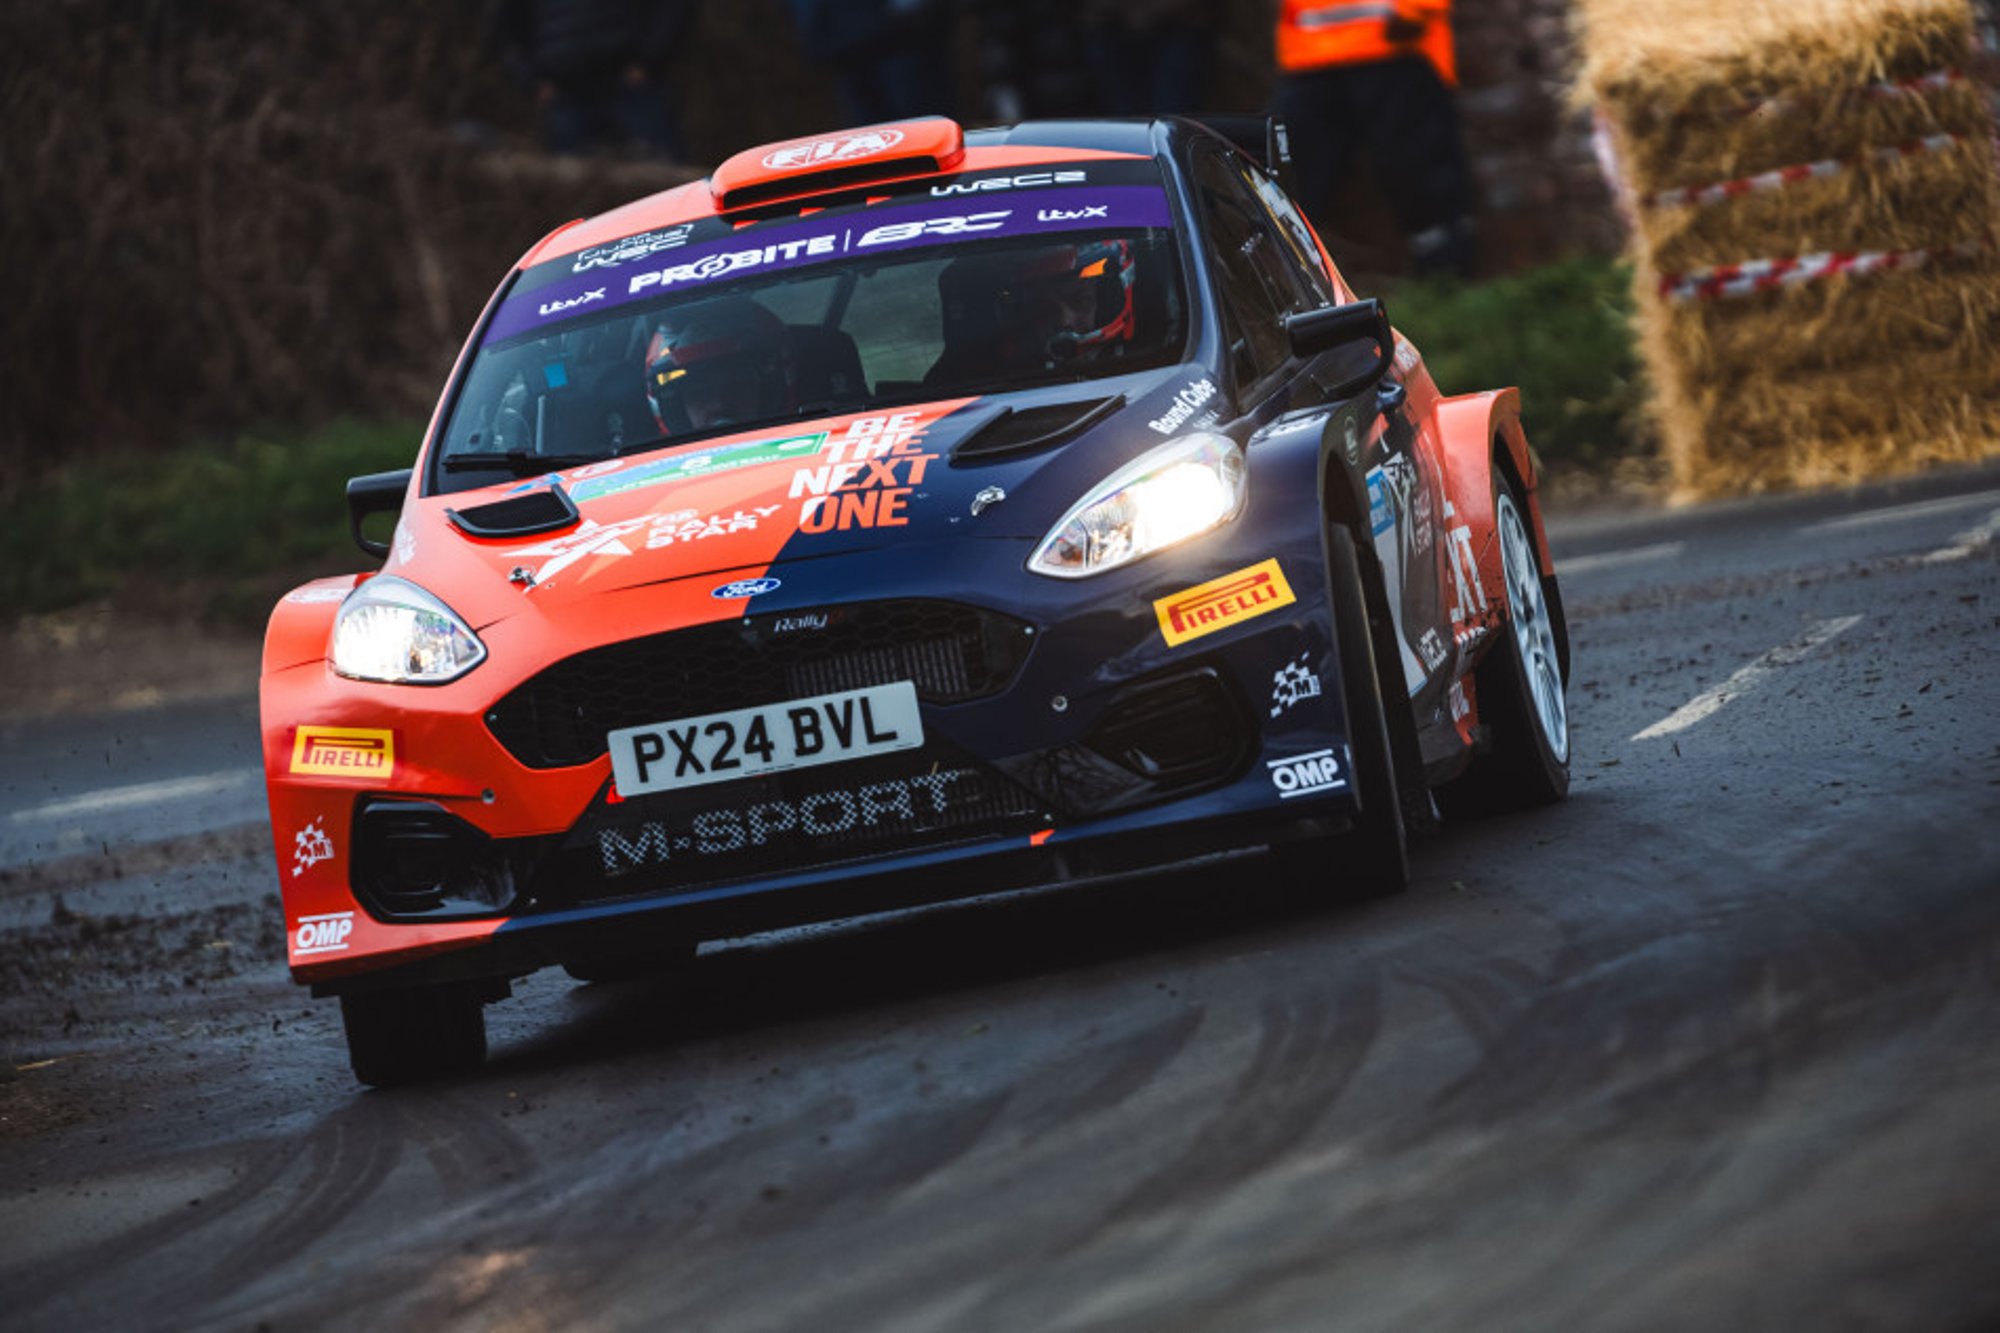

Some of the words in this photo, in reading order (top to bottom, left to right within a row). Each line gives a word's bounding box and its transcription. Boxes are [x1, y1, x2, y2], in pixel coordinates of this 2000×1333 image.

[770, 133, 889, 168] FIA
[845, 411, 923, 439] BE
[824, 430, 930, 464] THE
[788, 453, 941, 499] NEXT
[646, 504, 783, 540] RALLY
[798, 487, 914, 535] ONE
[644, 514, 759, 549] STAR
[1167, 571, 1278, 634] PIRELLI
[774, 612, 829, 633] Rally
[300, 735, 385, 769] PIRELLI
[632, 714, 775, 784] PX24
[788, 696, 898, 758] BVL
[1272, 756, 1339, 791] OMP
[296, 919, 354, 949] OMP
